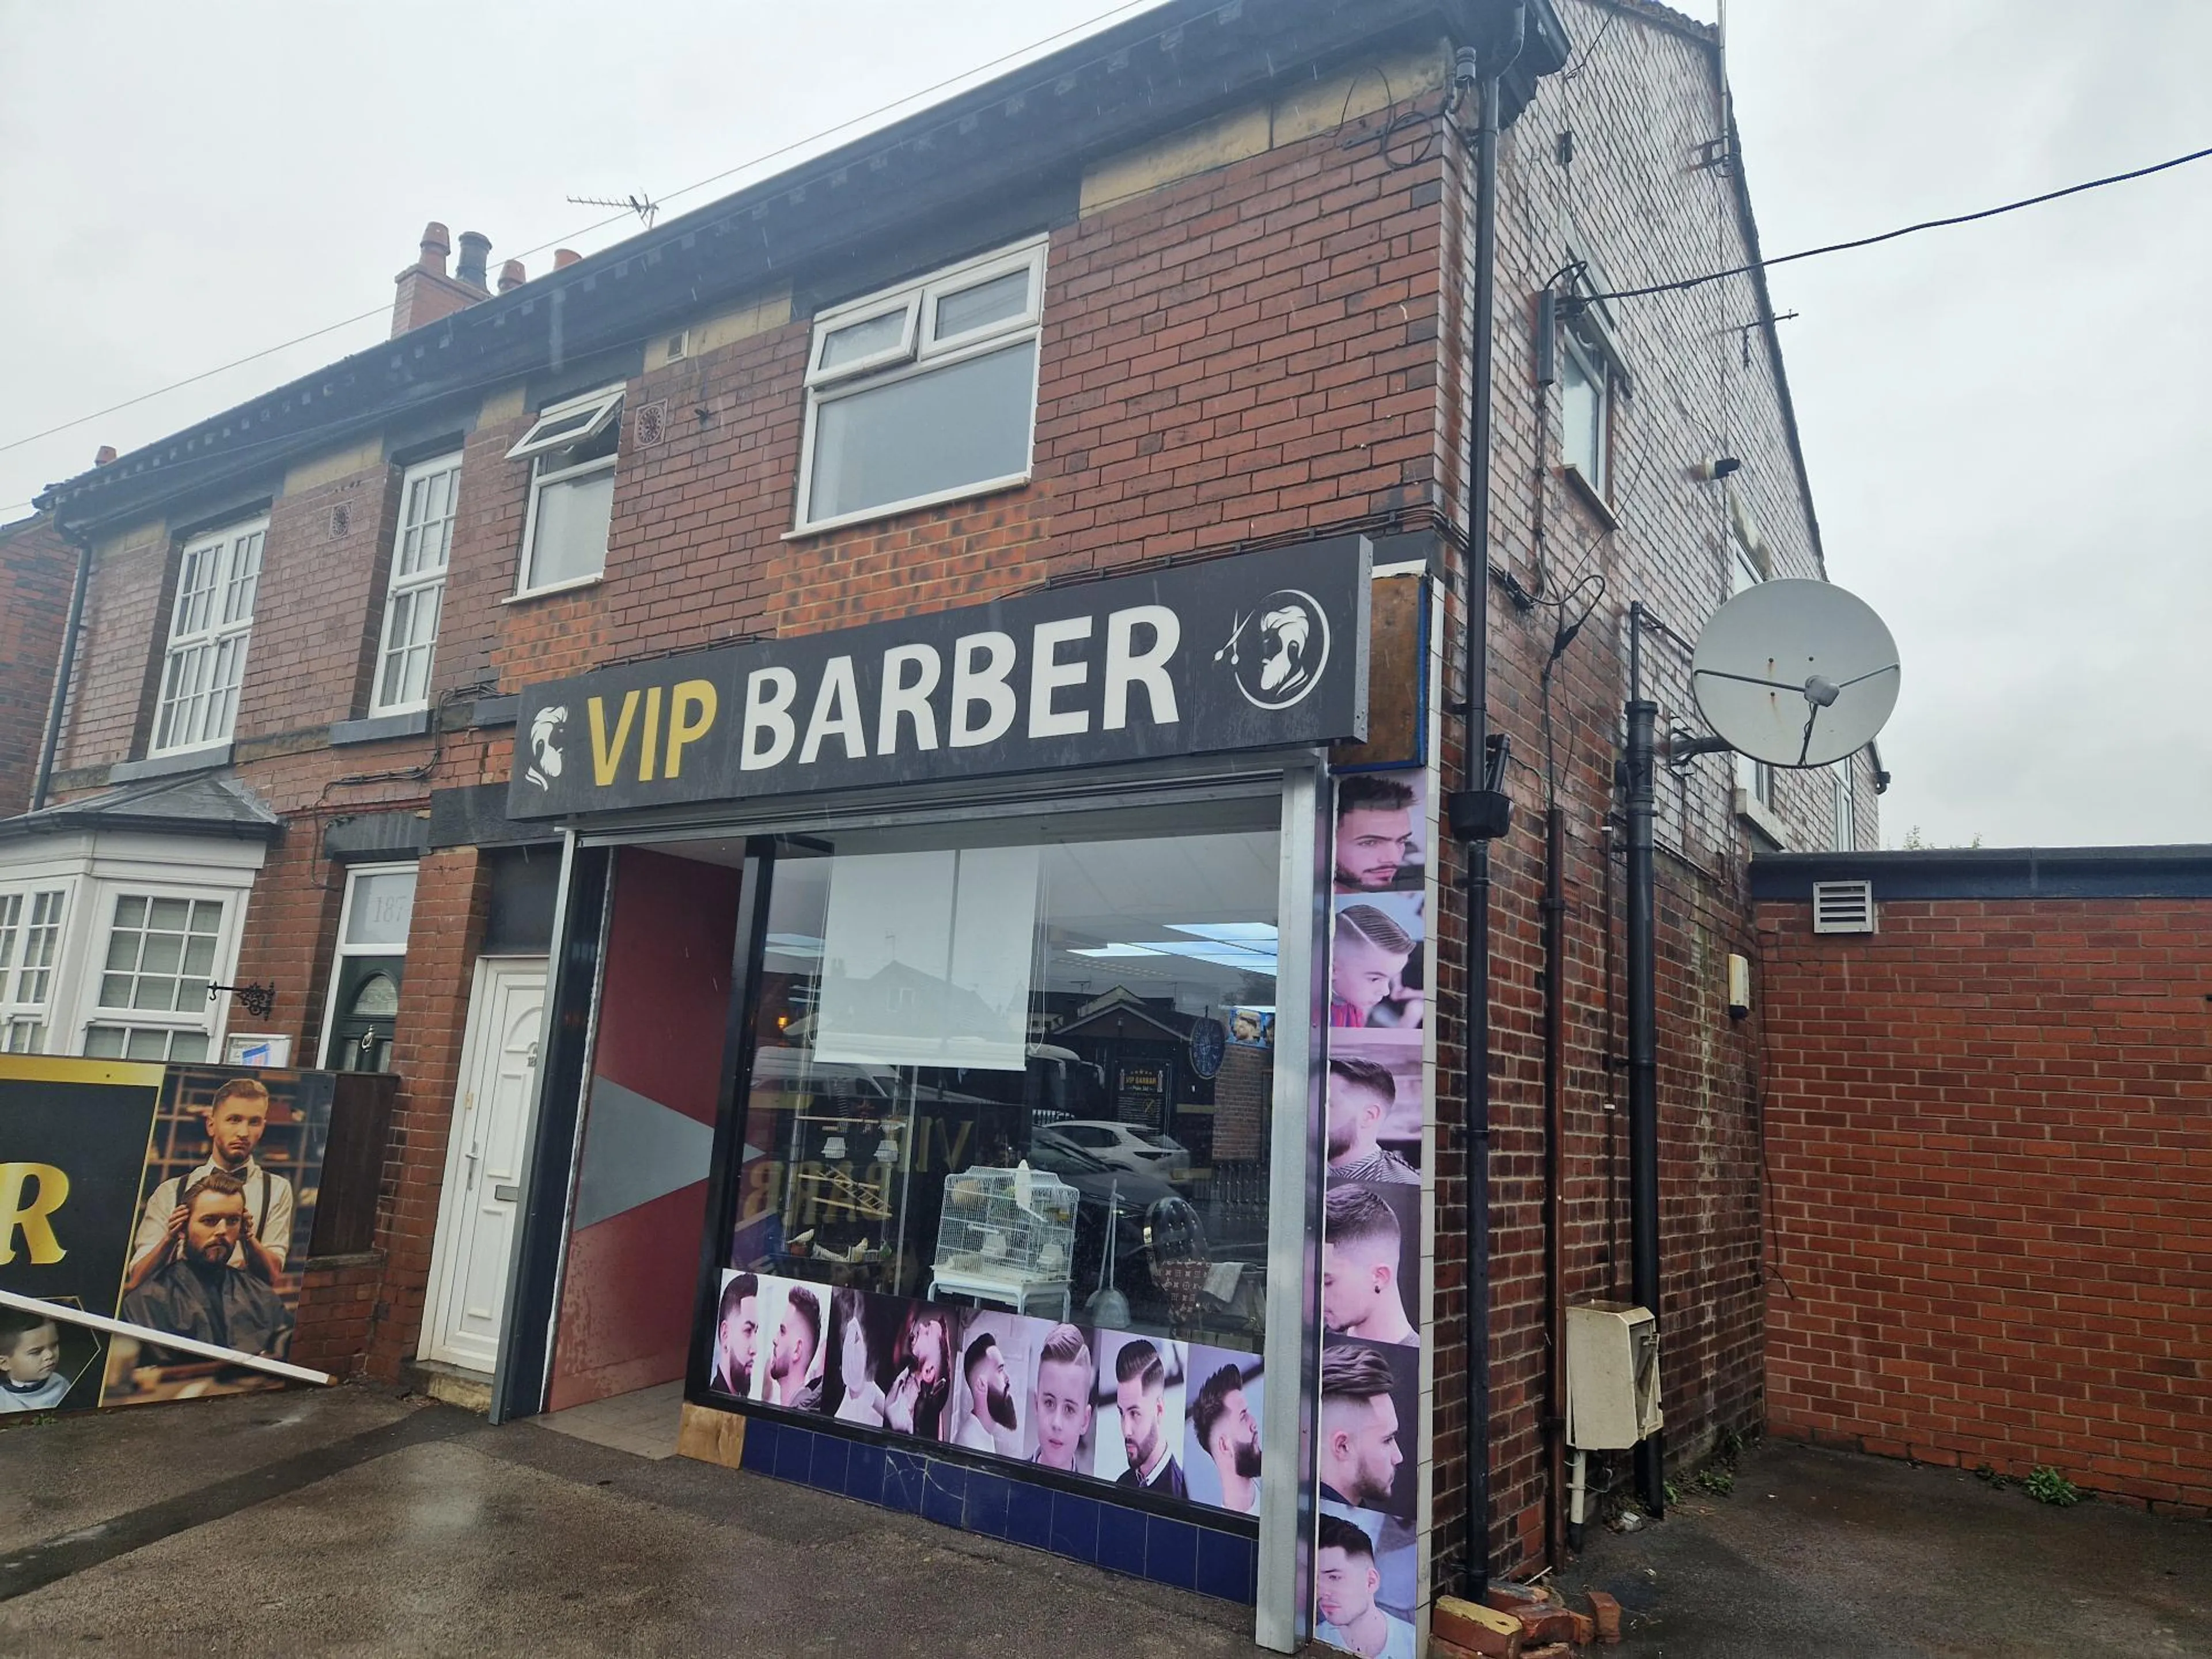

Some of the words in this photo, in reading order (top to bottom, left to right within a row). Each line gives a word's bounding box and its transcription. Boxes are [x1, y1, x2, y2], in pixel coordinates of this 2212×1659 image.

[588, 680, 718, 786] VIP
[740, 604, 1181, 771] BARBER
[371, 896, 407, 922] 187
[0, 1162, 69, 1265] R
